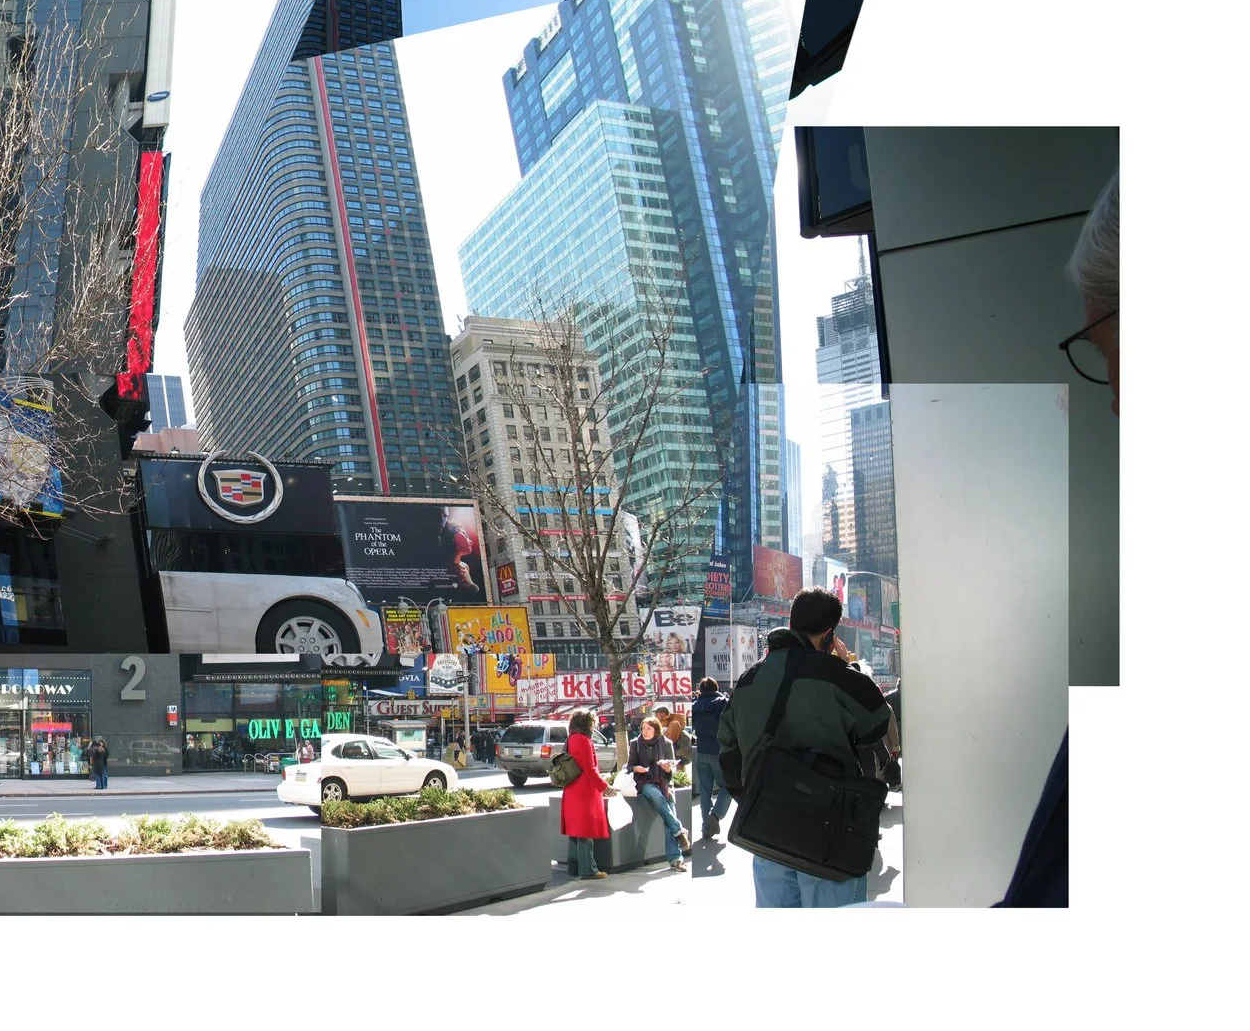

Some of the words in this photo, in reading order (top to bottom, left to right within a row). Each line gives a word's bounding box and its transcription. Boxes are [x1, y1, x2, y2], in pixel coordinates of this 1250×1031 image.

[355, 533, 401, 542] PHANTOM
[364, 547, 395, 556] OPERA
[491, 611, 512, 628] ALL
[479, 627, 524, 645] SHOOK
[120, 655, 146, 701] 2
[377, 701, 420, 716] GUEST
[248, 719, 294, 740] OLIVE
